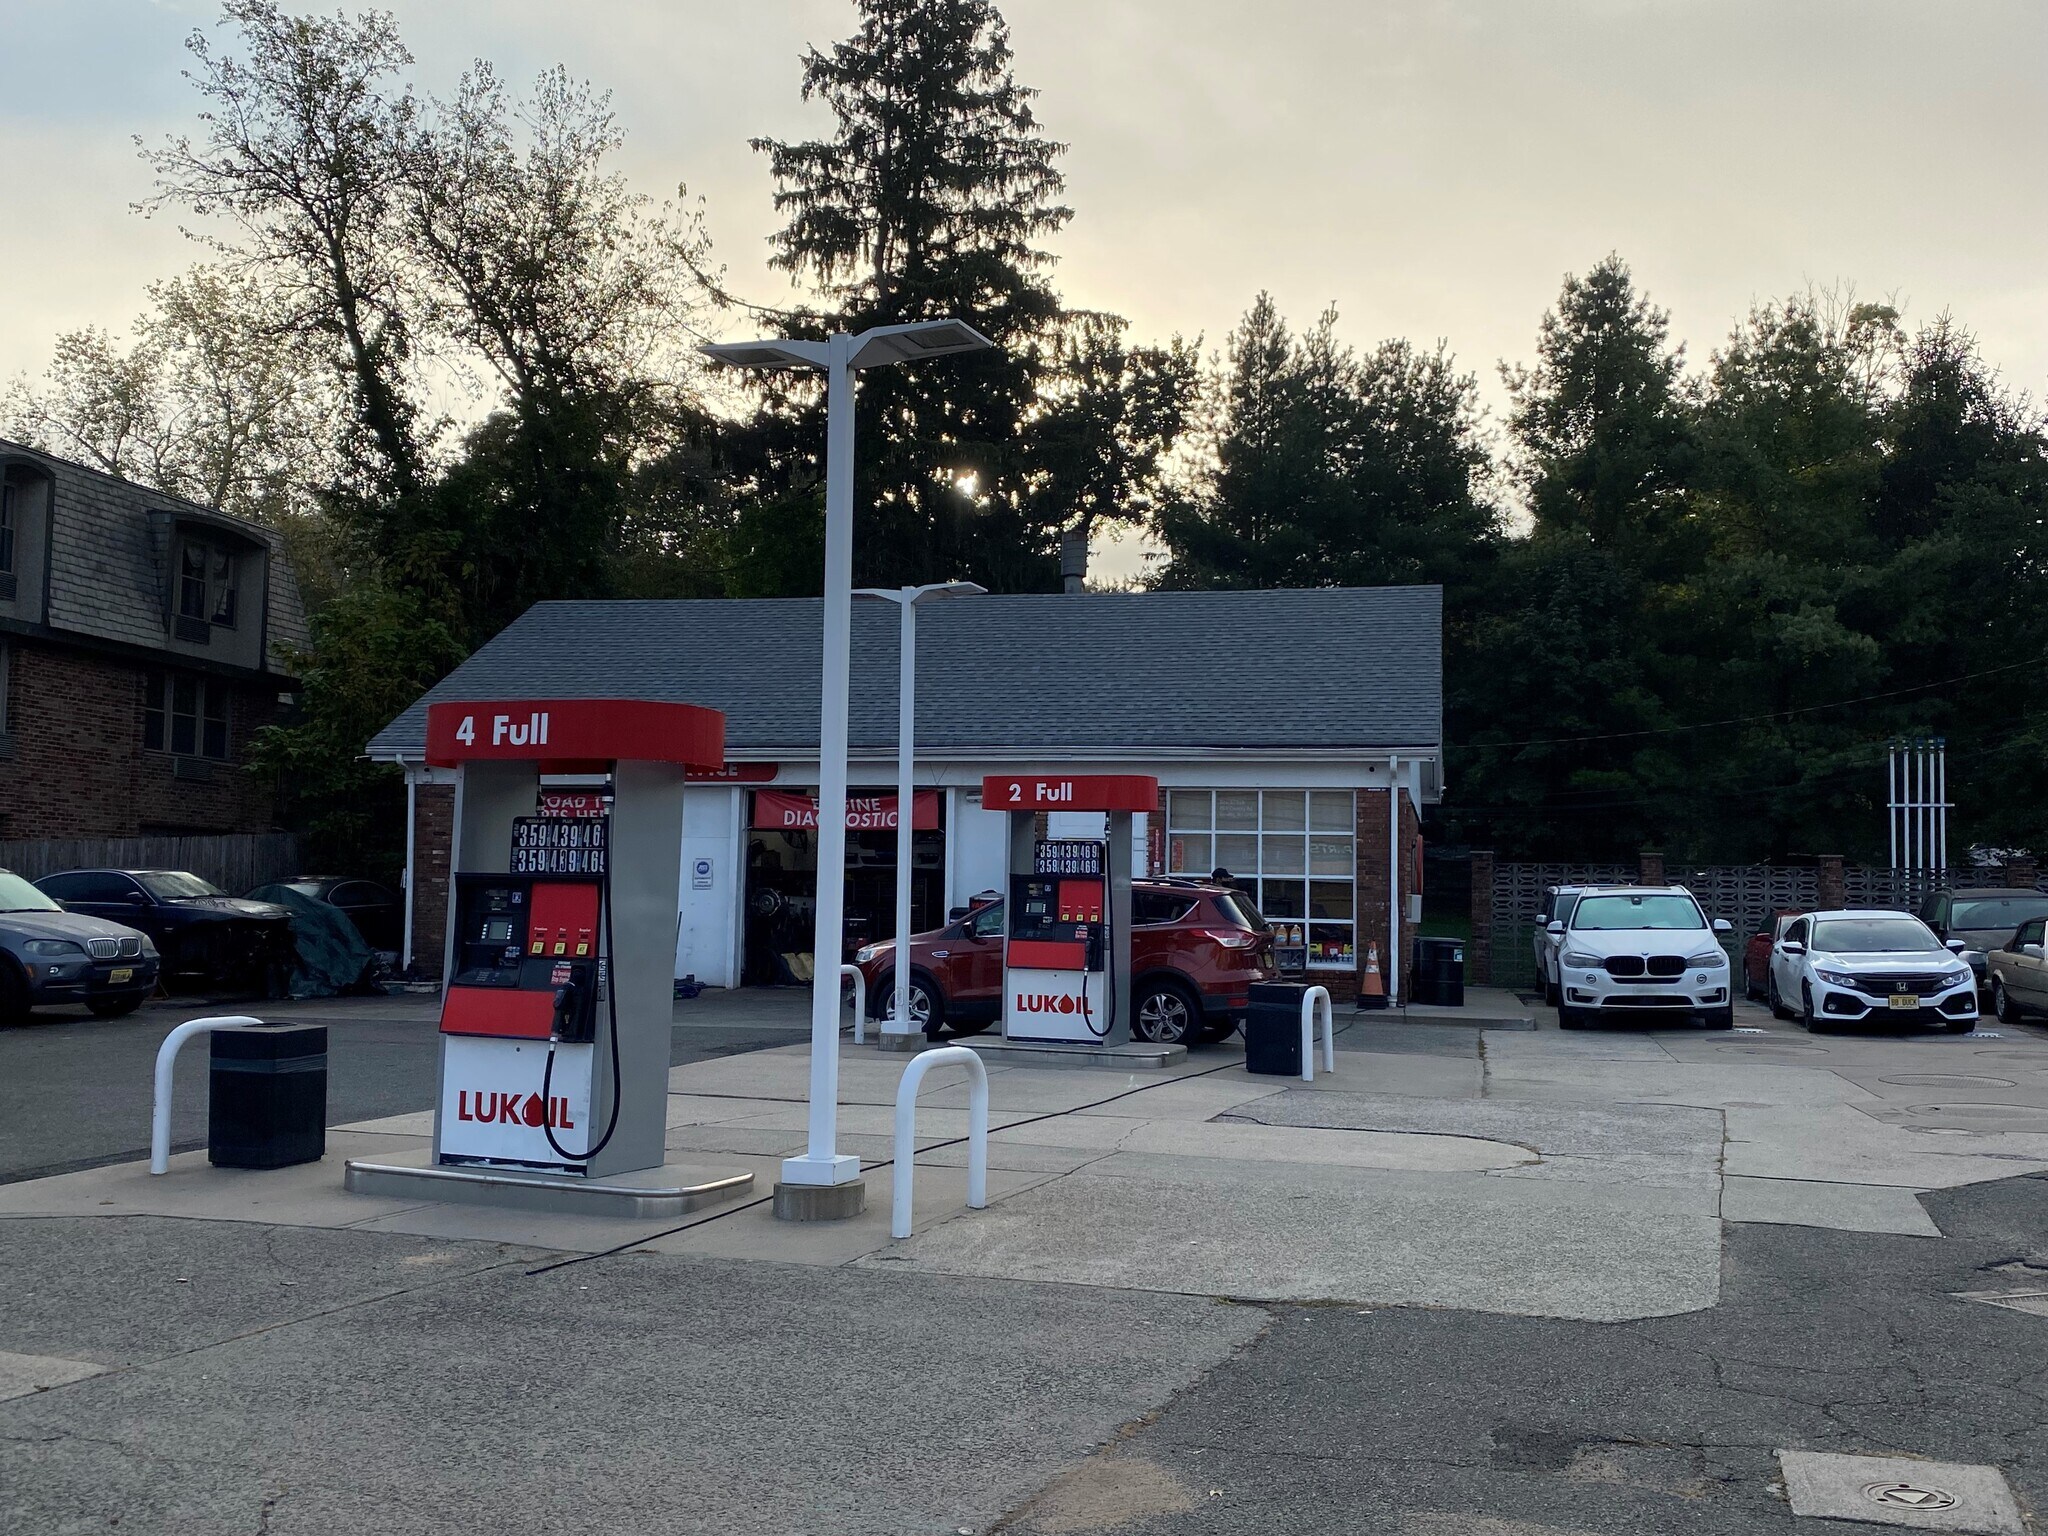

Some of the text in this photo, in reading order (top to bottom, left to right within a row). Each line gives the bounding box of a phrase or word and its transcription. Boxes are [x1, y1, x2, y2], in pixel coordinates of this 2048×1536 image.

[456, 712, 549, 746] 4 Full
[1008, 782, 1072, 801] 2 Full
[811, 798, 881, 811] EINE
[783, 810, 898, 827] DIAOSTIC
[519, 824, 547, 846] 3.59
[552, 824, 579, 847] 4.39
[583, 824, 604, 847] 4.6
[518, 850, 546, 872] 3.59
[550, 850, 577, 872] 4.39
[1017, 993, 1093, 1015] LUKOIL
[458, 1090, 574, 1129] LUKOIL
